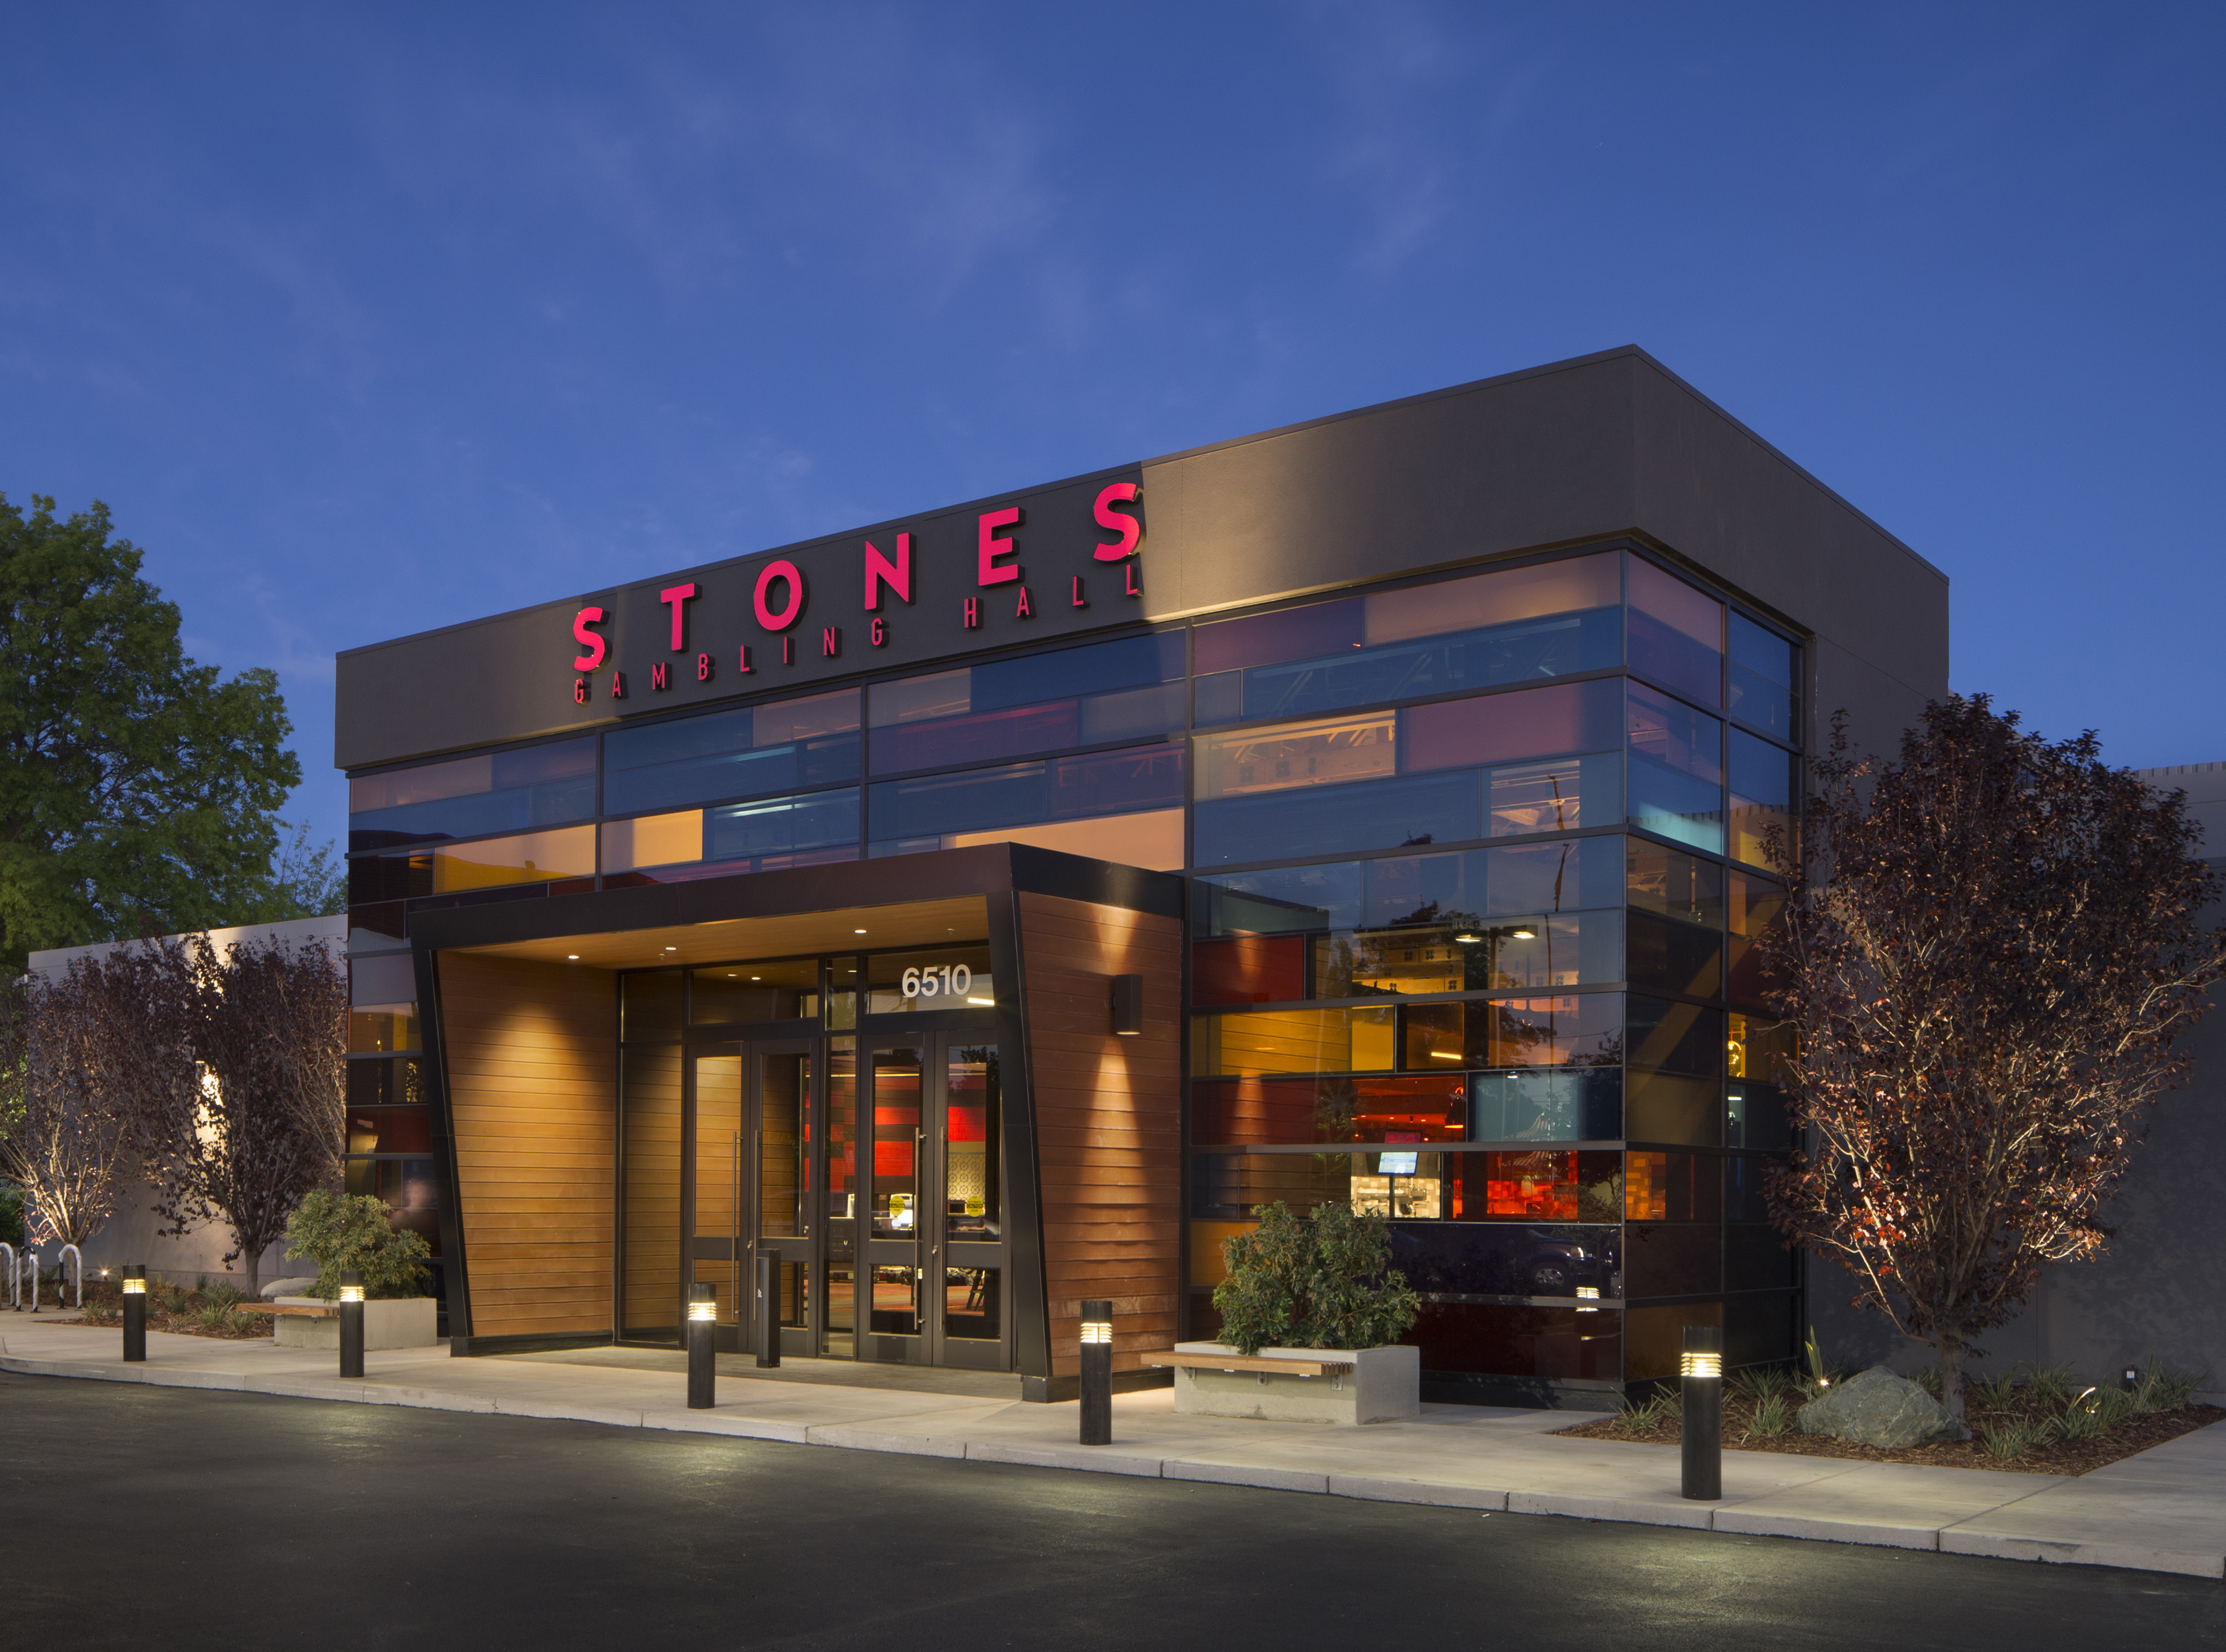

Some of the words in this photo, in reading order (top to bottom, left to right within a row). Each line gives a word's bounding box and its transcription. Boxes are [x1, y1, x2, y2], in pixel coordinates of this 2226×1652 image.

[573, 483, 1141, 672] STONES
[575, 618, 883, 704] GAMBLING
[964, 564, 1139, 628] HALL
[902, 964, 971, 997] 6510
